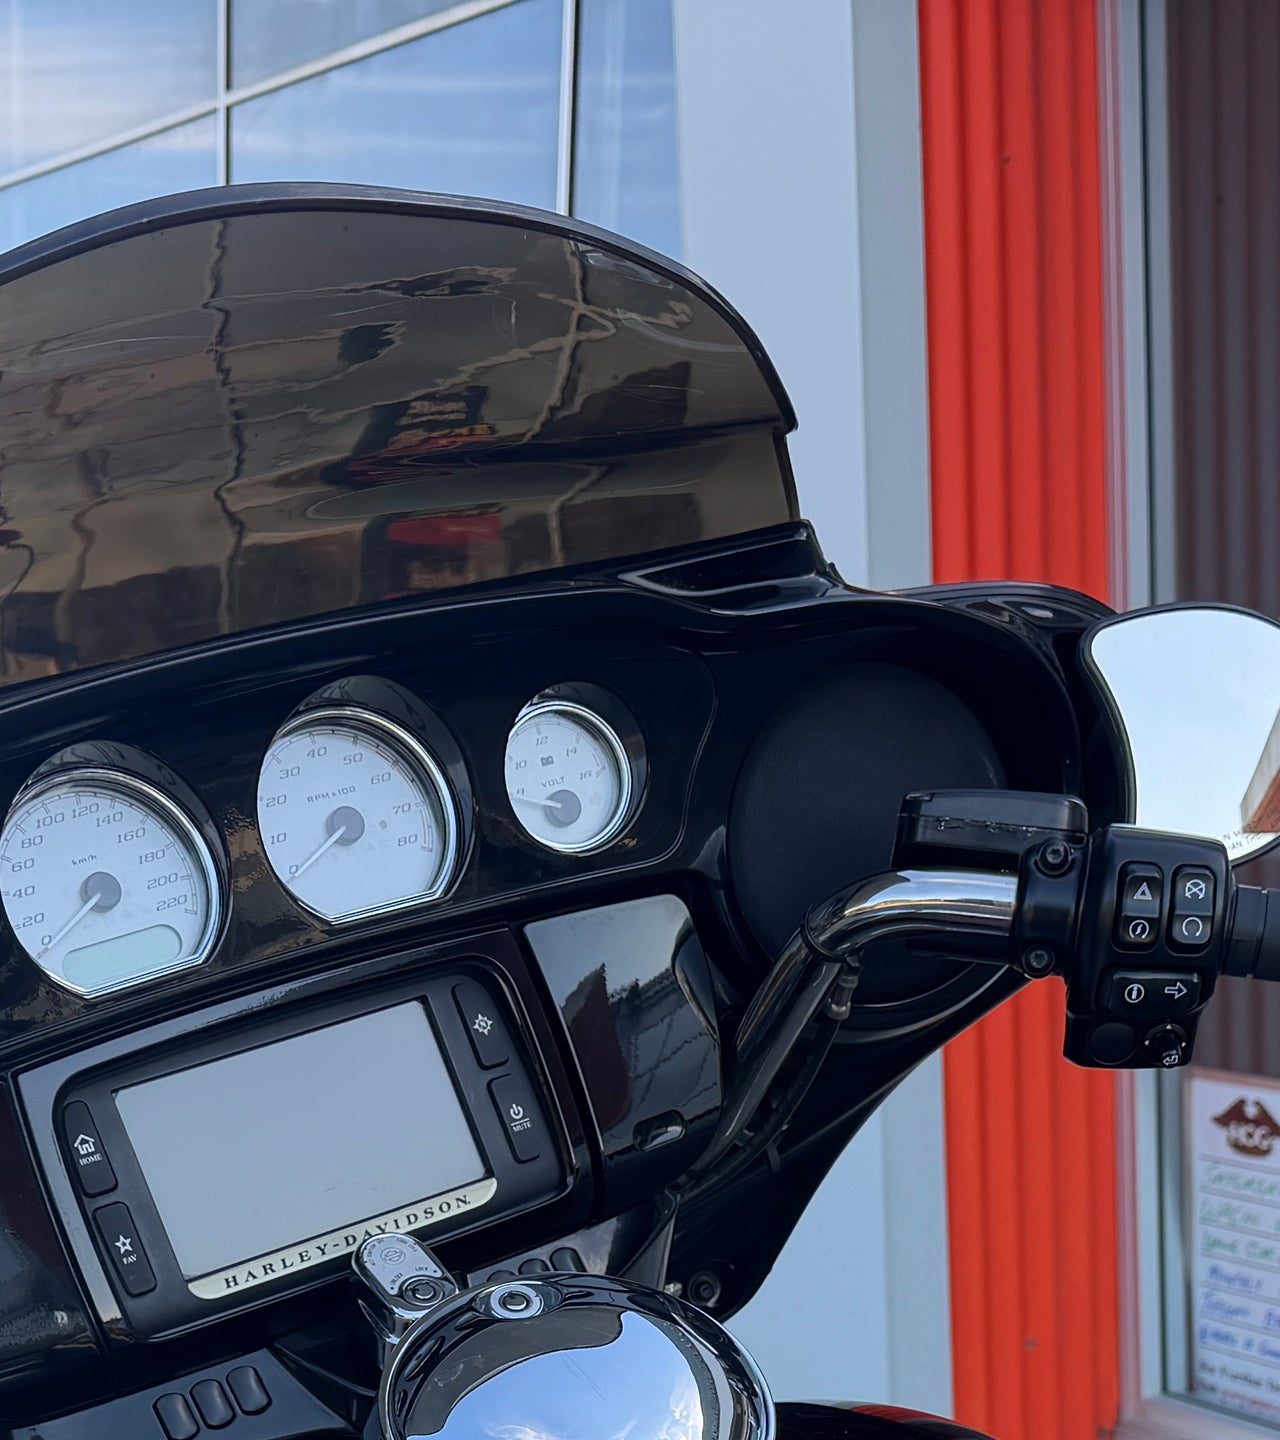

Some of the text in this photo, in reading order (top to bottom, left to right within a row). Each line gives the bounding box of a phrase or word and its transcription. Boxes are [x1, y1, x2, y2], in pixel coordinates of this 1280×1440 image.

[536, 736, 548, 746] 12
[306, 746, 328, 759] 40
[342, 752, 364, 766] 50
[279, 766, 301, 780] 30
[370, 772, 392, 785] 60
[541, 776, 566, 788] VOLT
[265, 794, 288, 808] 20
[71, 803, 100, 819] 120
[392, 802, 412, 815] 70
[35, 812, 65, 829] 100
[95, 811, 124, 828] 140
[21, 835, 44, 849] 80
[117, 827, 147, 844] 160
[270, 832, 287, 846] 10
[397, 834, 418, 847] 80
[72, 854, 98, 866] km/h
[138, 848, 166, 866] 180
[11, 858, 35, 873] 60
[289, 863, 300, 875] 0
[147, 872, 179, 890] 200
[12, 885, 36, 899] 40
[156, 894, 188, 912] 220
[22, 912, 45, 928] 20
[41, 934, 53, 947] 0
[512, 1121, 533, 1133] MUTE
[79, 1152, 104, 1167] HOME
[223, 1194, 471, 1290] HARLEY-DAVIDSON
[122, 1253, 137, 1265] FAV
